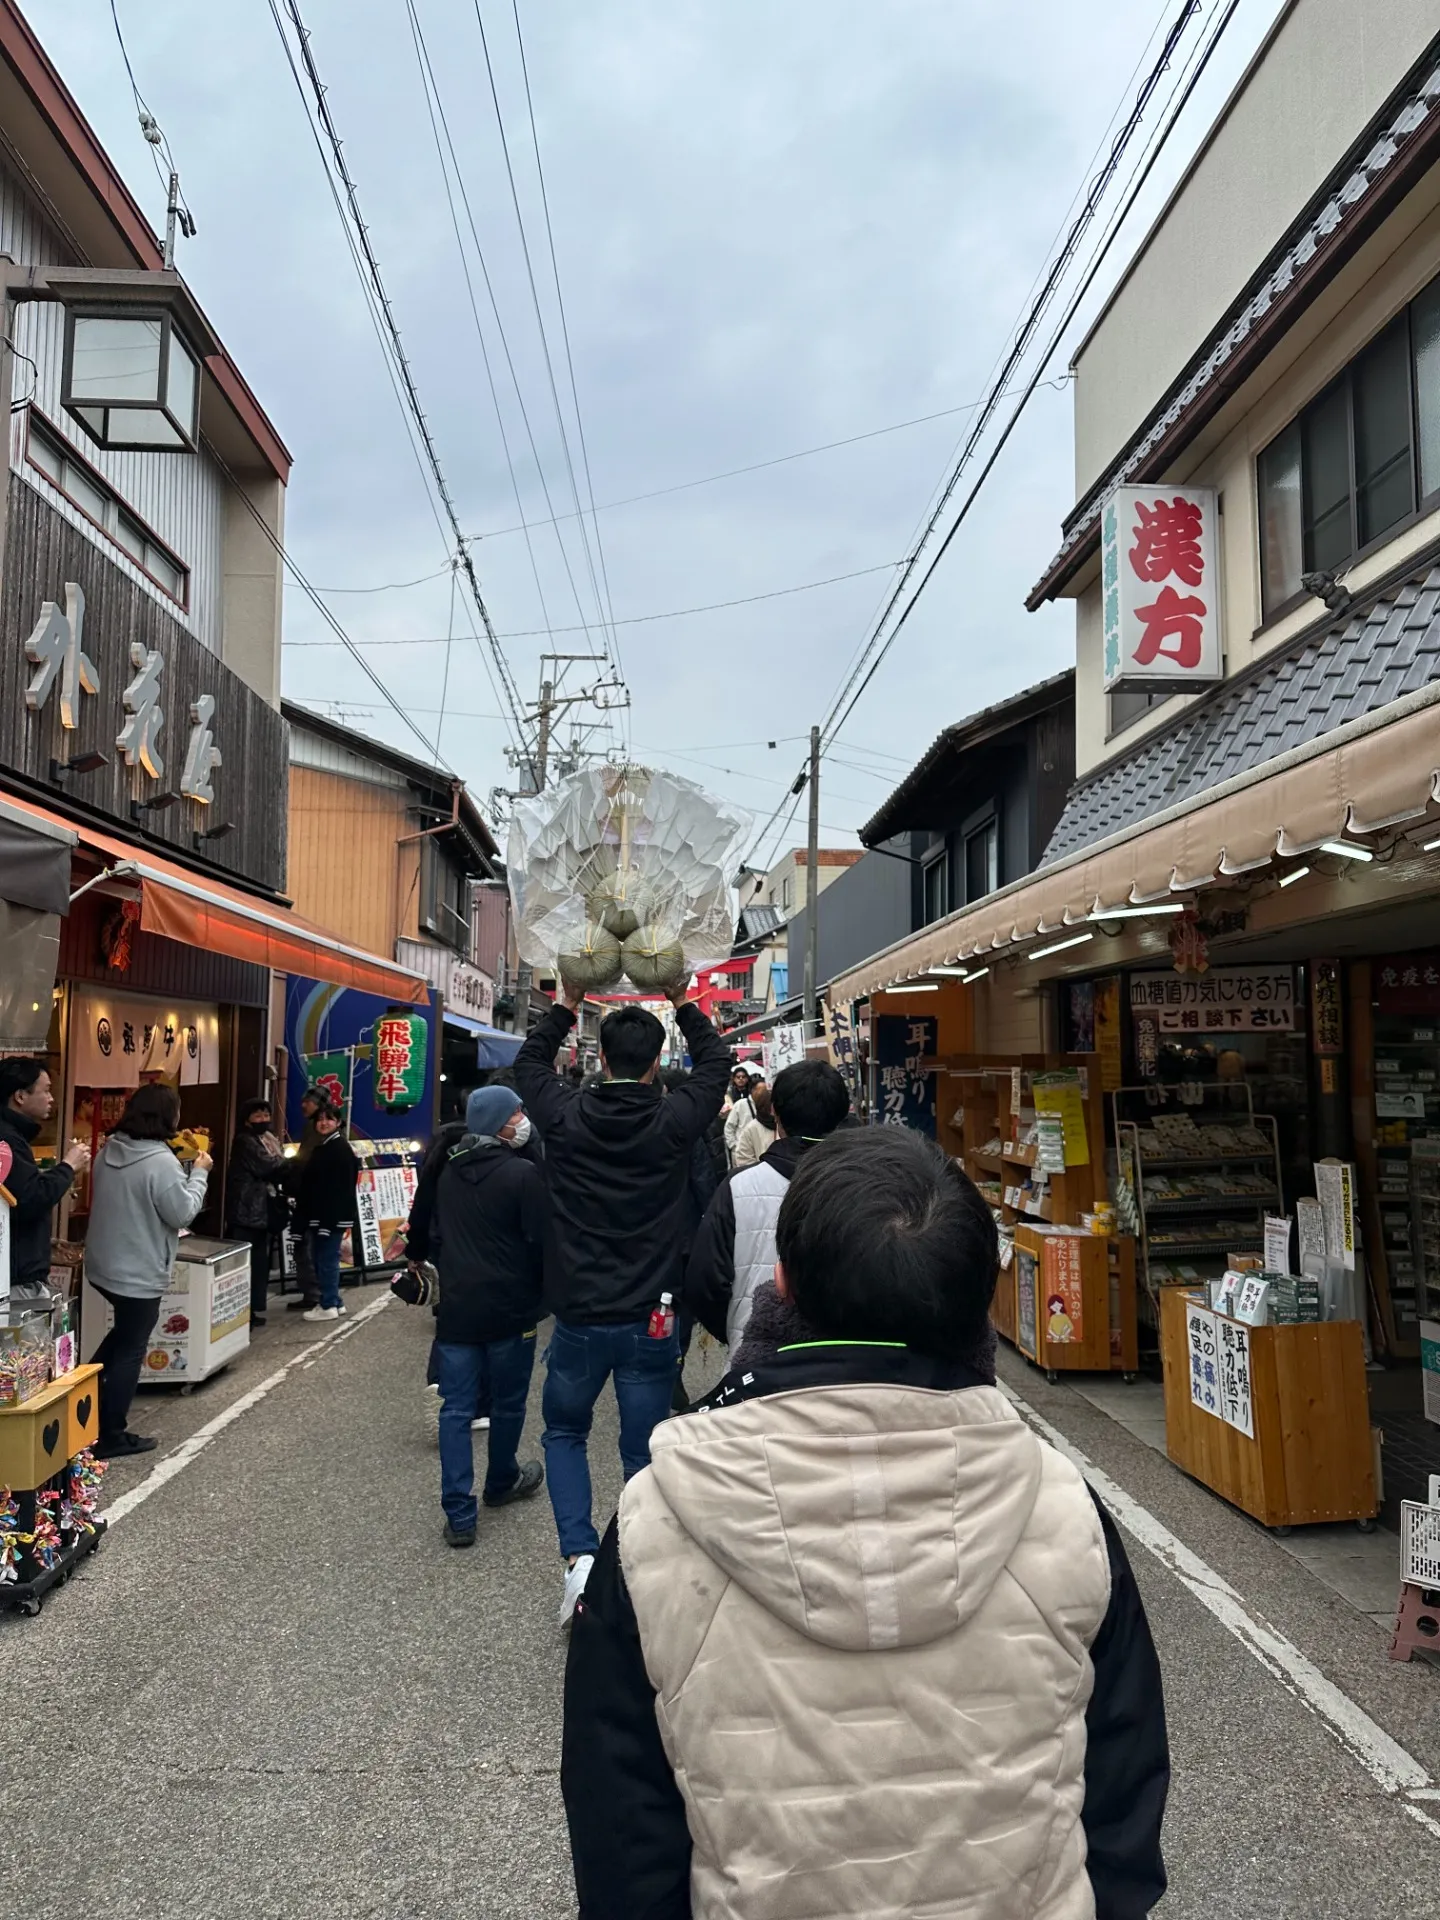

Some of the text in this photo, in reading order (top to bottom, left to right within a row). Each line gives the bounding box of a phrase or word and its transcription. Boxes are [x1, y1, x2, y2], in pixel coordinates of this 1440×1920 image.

[1128, 496, 1207, 668] 漢方
[378, 1020, 412, 1101] 飛騨牛
[1163, 1007, 1289, 1028] ご相談下さい
[904, 1022, 931, 1104] 耳鳴り
[1221, 1323, 1239, 1422] 聴力低下
[1235, 1330, 1250, 1428] 耳鳴り
